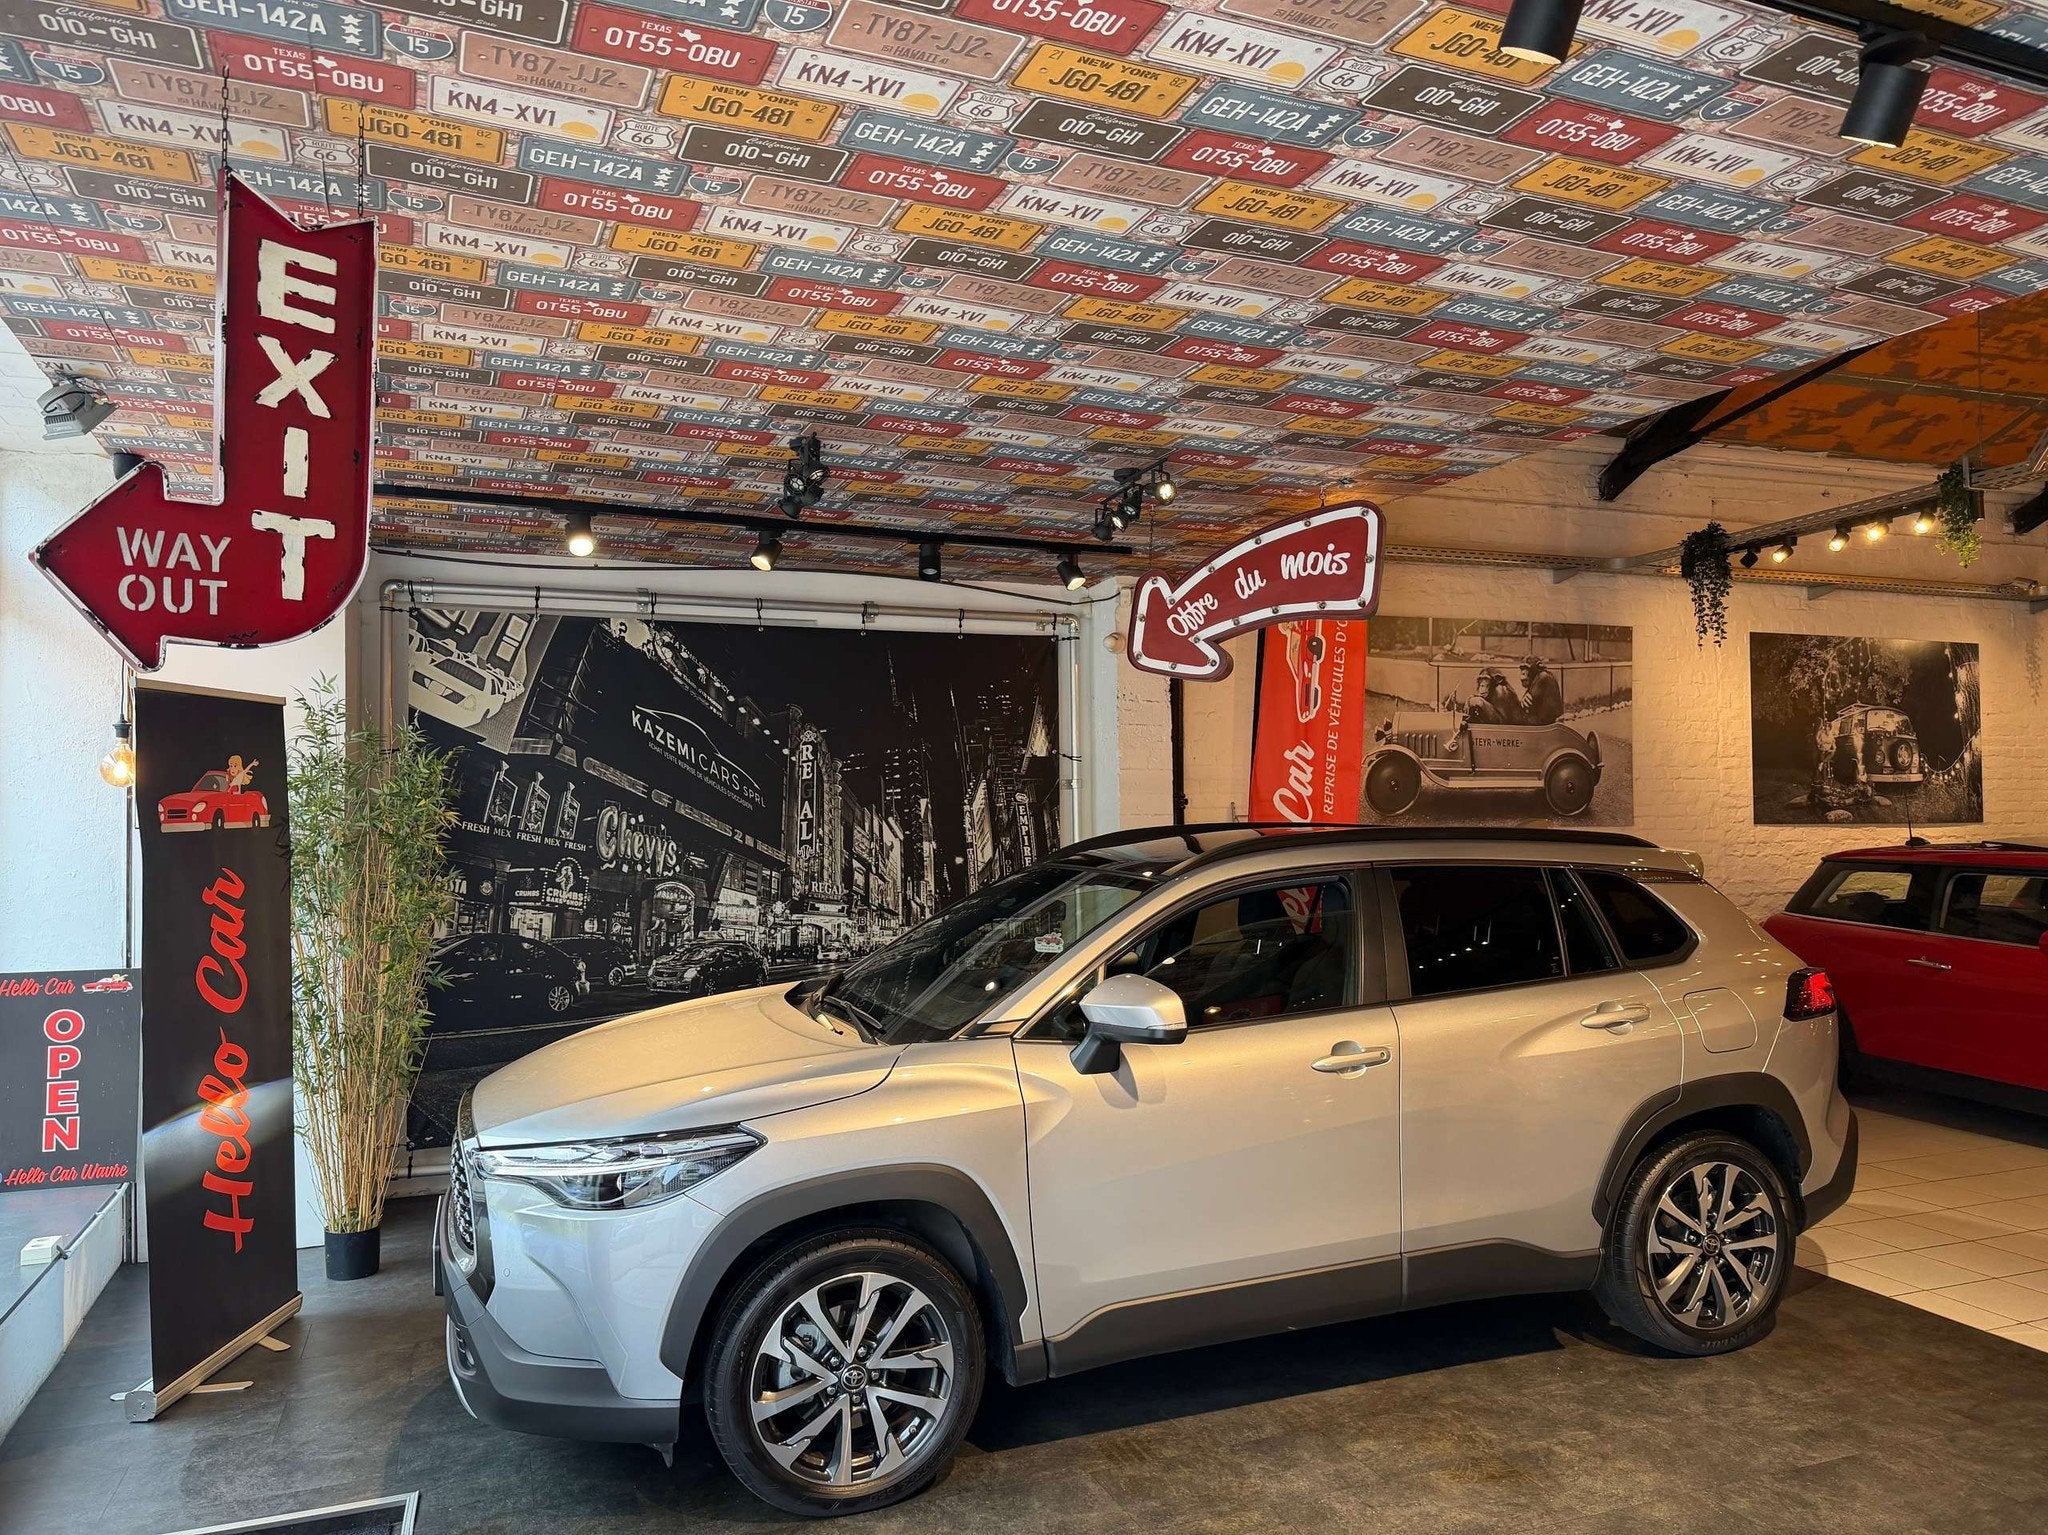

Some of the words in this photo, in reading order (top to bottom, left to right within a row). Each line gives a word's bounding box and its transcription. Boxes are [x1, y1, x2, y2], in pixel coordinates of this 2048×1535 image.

[406, 35, 429, 53] 15
[54, 62, 82, 79] 15
[1075, 56, 1114, 69] NEW
[1119, 65, 1162, 80] YORK
[1567, 63, 1684, 103] GEH-142A
[1197, 95, 1313, 132] GEH-142A
[1709, 100, 1741, 116] 15
[852, 122, 966, 156] GEH-142A
[1353, 129, 1379, 143] 15
[528, 148, 641, 179] GEH-142A
[1018, 156, 1040, 169] 15
[406, 196, 423, 208] 15
[1652, 193, 1749, 221] GEH-142A
[1341, 216, 1437, 242] GEH-142A
[1047, 238, 1142, 262] GEH-142A
[506, 271, 599, 292] GEH-142A
[770, 256, 864, 278] GEH-142A
[11, 301, 118, 320] GEH-142A
[252, 238, 337, 601] EXIT
[116, 526, 232, 573] WAY
[1234, 567, 1267, 600] du
[1280, 543, 1351, 580] mois
[117, 574, 228, 616] OUT
[1327, 646, 1347, 727] VÉHICULES
[1326, 729, 1340, 751] DE
[631, 709, 696, 764] KAZEMI
[699, 753, 741, 792] CARS
[742, 784, 767, 808] SPRL
[800, 744, 815, 841] REGAL
[1323, 751, 1339, 816] REPRISE
[461, 820, 490, 834] FRESH
[493, 827, 512, 838] MEX
[516, 832, 542, 844] FRESH
[543, 836, 561, 847] MEX
[564, 841, 587, 852] FRESH
[596, 805, 677, 877] Chevys
[1019, 805, 1032, 867] EMPIRE
[546, 887, 585, 902] CRUMBS
[195, 867, 248, 1014] Car
[44, 977, 76, 995] Car
[42, 1008, 86, 1153] OPEN
[197, 1026, 255, 1254] Hello
[4, 1168, 48, 1186] Hello
[50, 1164, 78, 1183] Car
